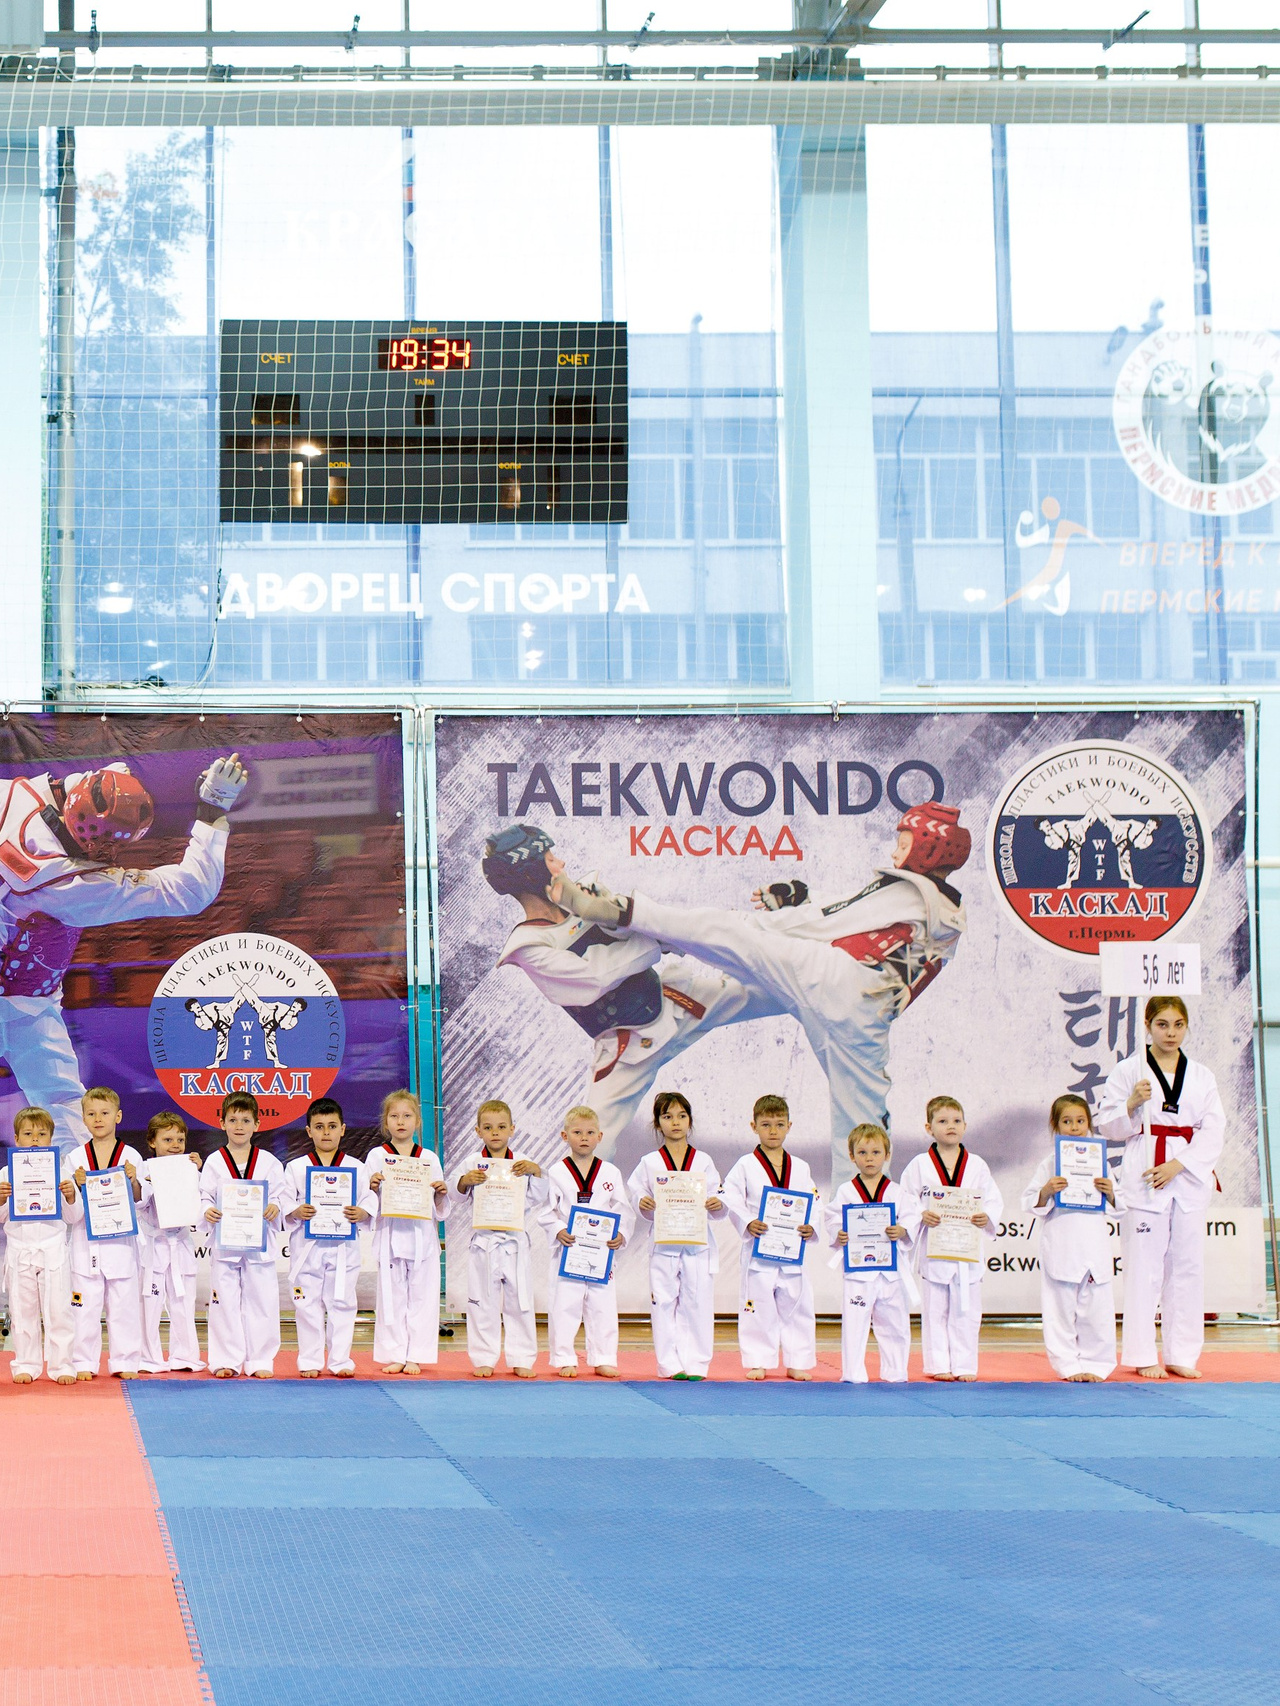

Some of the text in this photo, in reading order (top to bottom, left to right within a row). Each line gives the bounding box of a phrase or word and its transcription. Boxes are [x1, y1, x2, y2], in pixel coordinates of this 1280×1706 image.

[260, 352, 293, 365] СЧЕТ
[391, 338, 471, 371] 19:34
[557, 353, 590, 366] СЧЕТ
[1248, 543, 1266, 565] К
[219, 572, 651, 620] ДВОРЕЦ СПОРТА
[1101, 589, 1263, 614] ПЕРМСКИЕ
[486, 760, 945, 817] TAEKWONDO
[1045, 777, 1150, 807] TAEKWONDO
[999, 755, 1199, 885] ШКОЛА ПЛАСТИКИ И БОЕВЫХ ИСКУССТВ
[629, 825, 803, 862] КАСКАД
[1029, 891, 1169, 920] КАСКАД
[1068, 927, 1136, 941] г.Пермь
[196, 960, 297, 989] TAEKWONDO
[1142, 953, 1186, 991] 5,6 лет
[154, 938, 340, 1064] ШКОЛА ПЛАСТИКИ И БОЕВЫХ ИСКУССТВ
[180, 1071, 312, 1099] КАСКАД
